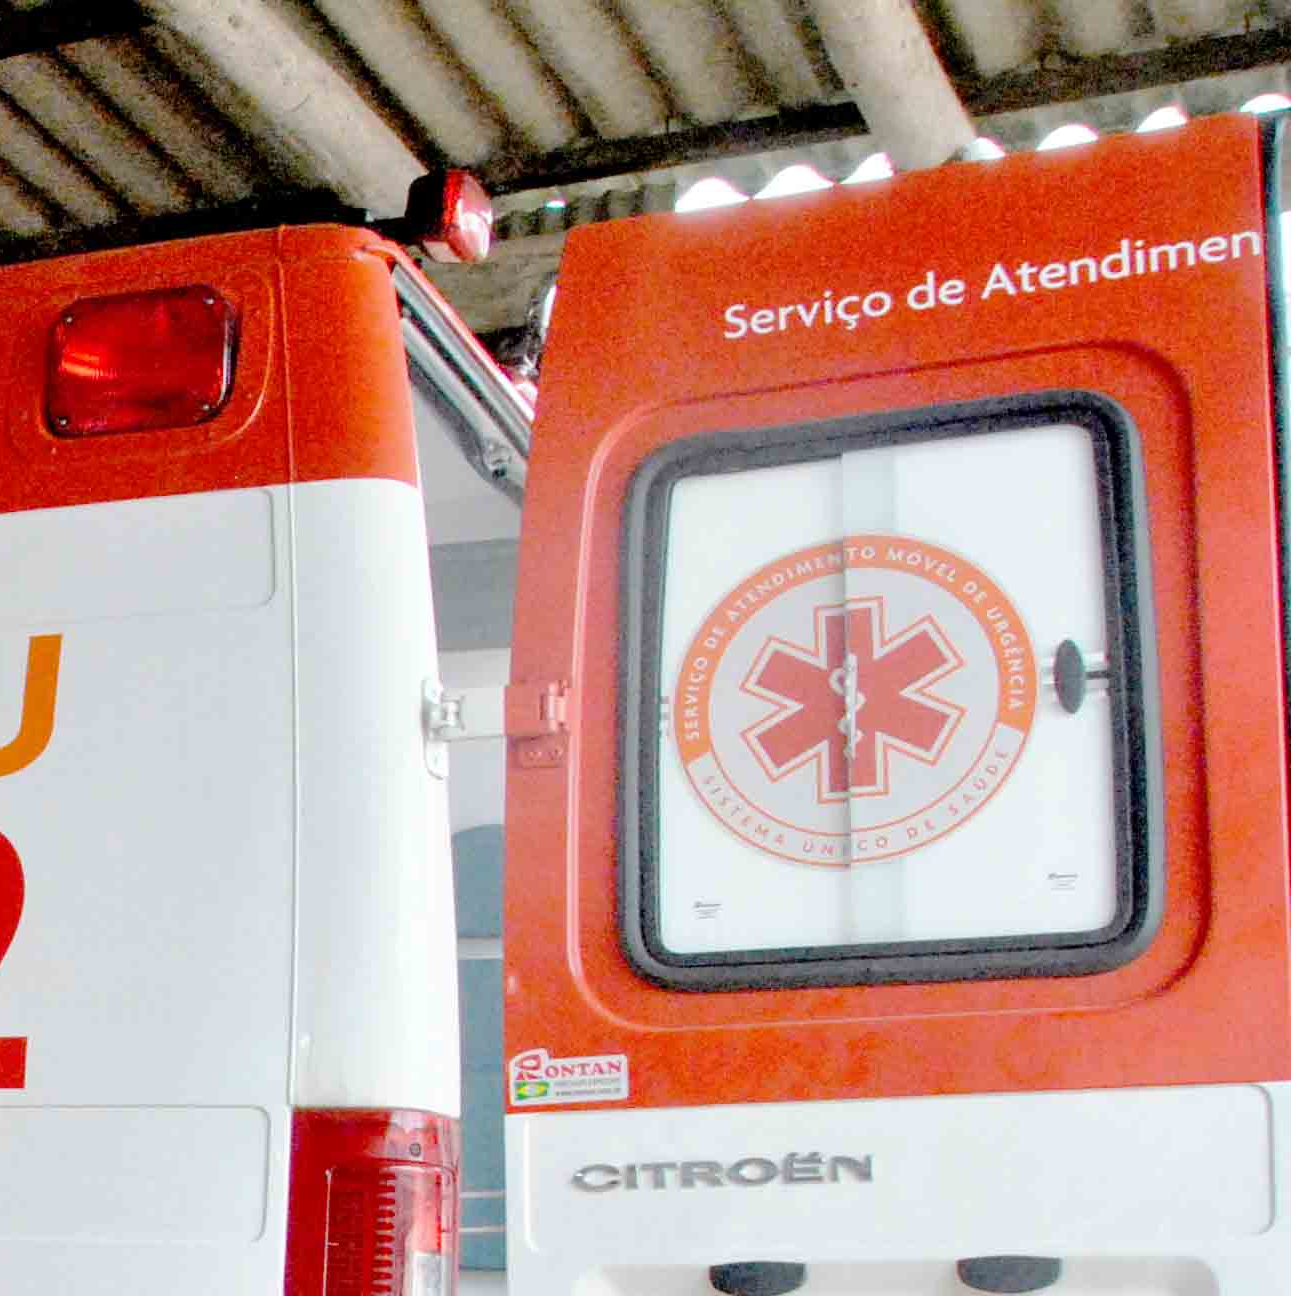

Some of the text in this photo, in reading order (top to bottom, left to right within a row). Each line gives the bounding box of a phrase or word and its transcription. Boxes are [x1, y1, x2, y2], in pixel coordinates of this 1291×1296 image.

[723, 287, 892, 341] Serviço
[906, 271, 966, 312] de
[682, 544, 1027, 742] SERVIÇO DE ATENDIMENTO MÓVEL DE URGÊNCIA
[905, 820, 937, 841] DE
[570, 1149, 874, 1193] CITROËN
